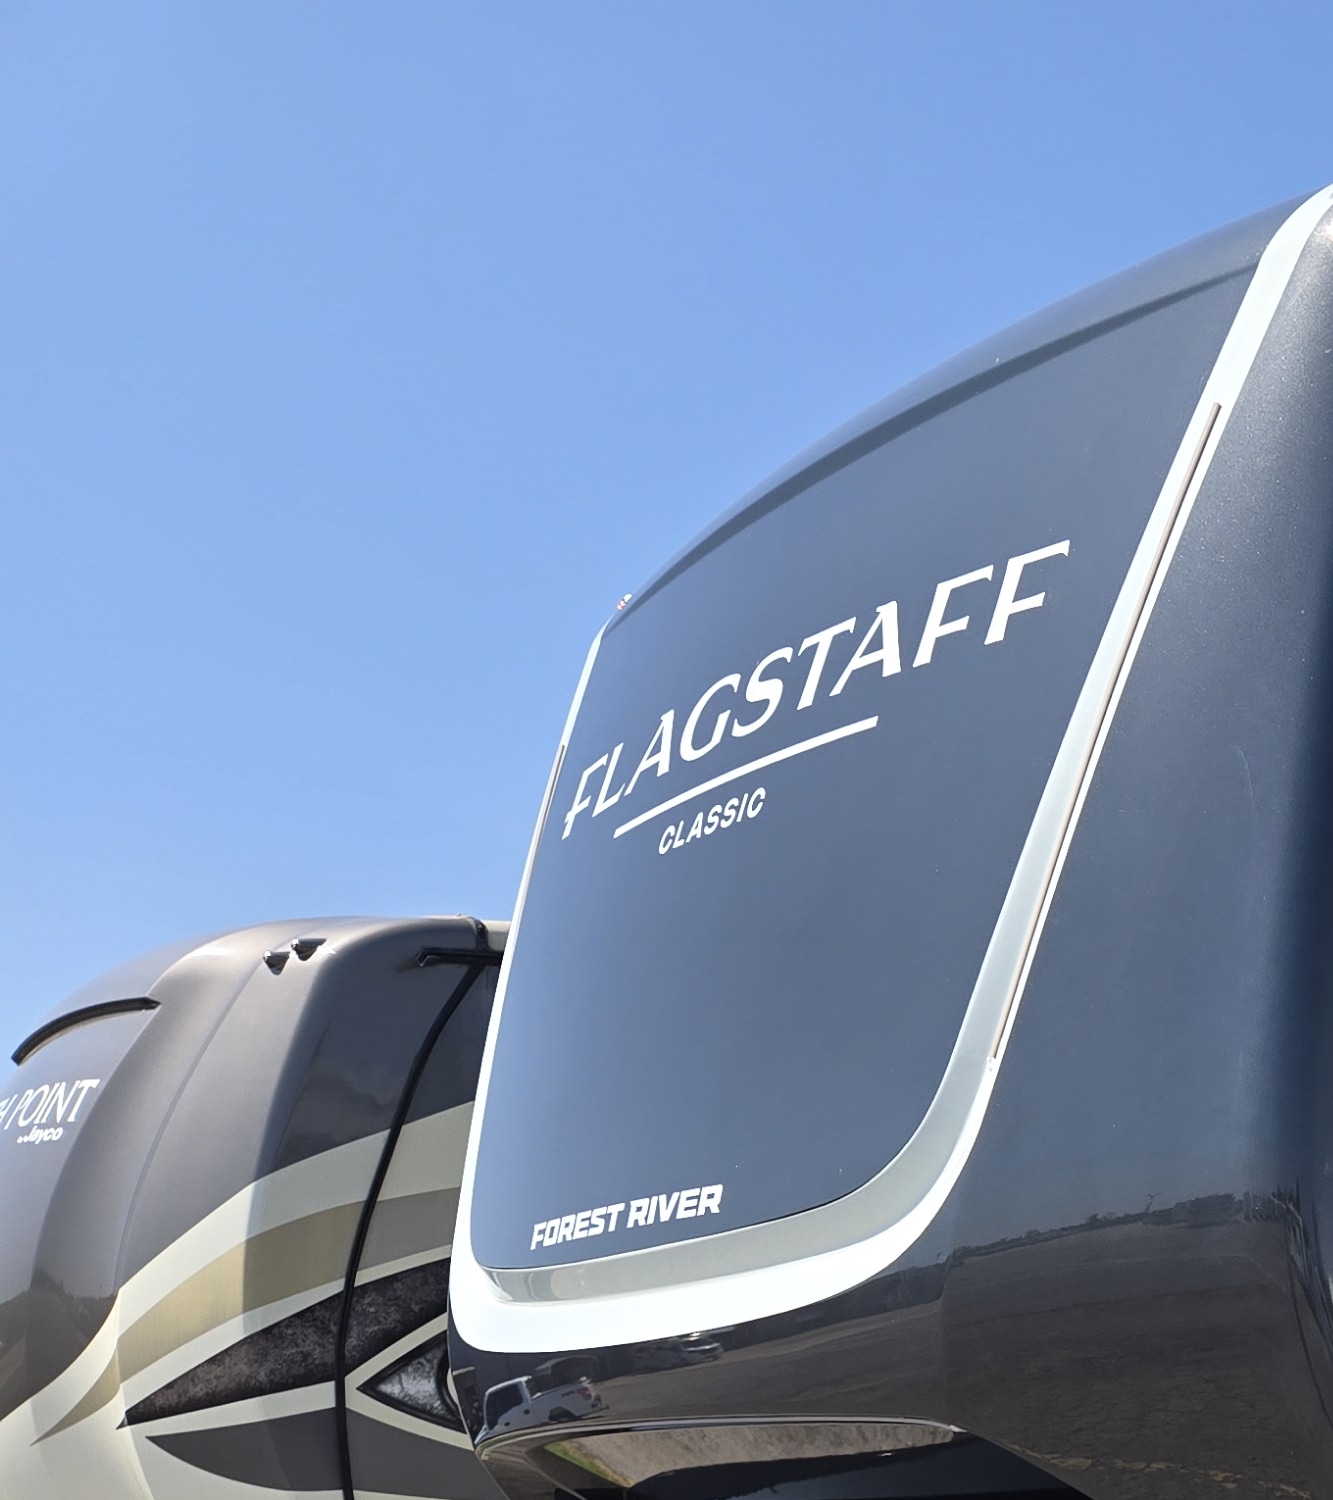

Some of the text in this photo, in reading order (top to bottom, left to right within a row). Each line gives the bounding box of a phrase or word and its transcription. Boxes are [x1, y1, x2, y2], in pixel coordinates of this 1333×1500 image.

[561, 540, 1070, 841] FLAGSTAFF
[658, 786, 766, 855] CLASSIC
[4, 1078, 101, 1131] POINT
[530, 1183, 724, 1251] FOREST RIVER
